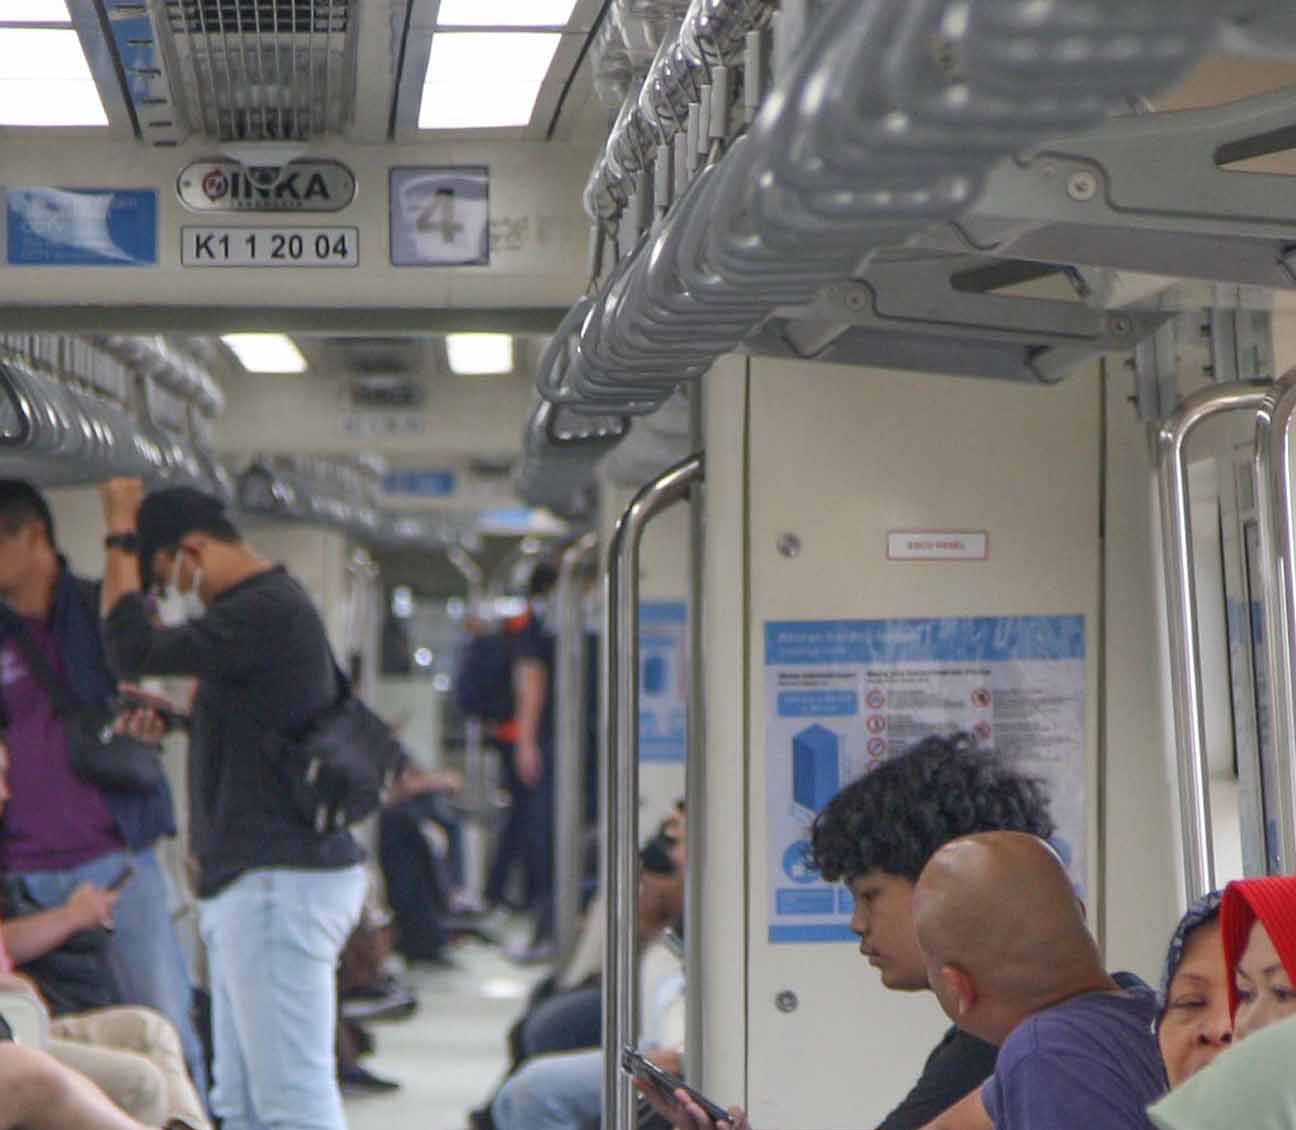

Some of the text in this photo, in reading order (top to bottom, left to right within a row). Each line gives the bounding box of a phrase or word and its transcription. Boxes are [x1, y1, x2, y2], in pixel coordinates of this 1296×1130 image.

[415, 186, 464, 244] 4
[195, 234, 348, 259] K1 1 20 04
